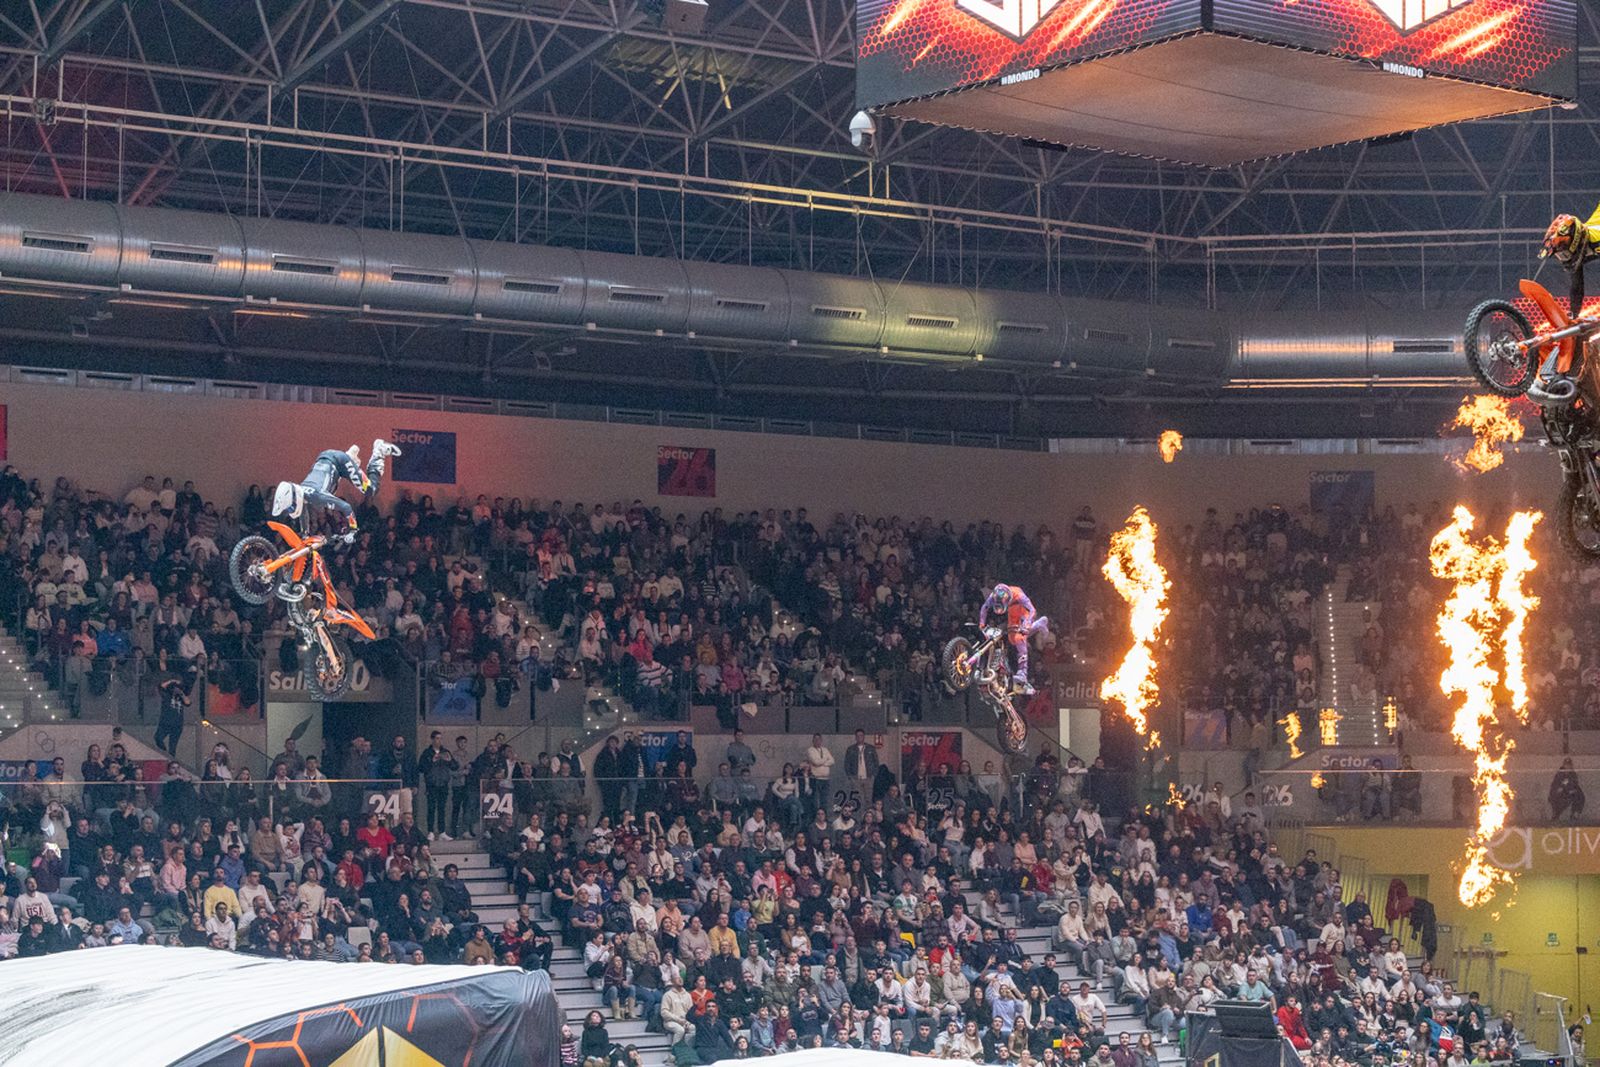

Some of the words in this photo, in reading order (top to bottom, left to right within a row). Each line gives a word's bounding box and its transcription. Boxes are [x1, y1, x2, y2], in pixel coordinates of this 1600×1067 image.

[391, 430, 433, 445] Sector
[656, 447, 694, 461] Sector
[1309, 471, 1350, 483] Sector
[901, 732, 940, 747] Sector
[1321, 754, 1369, 768] Sector
[834, 790, 862, 812] 25
[928, 788, 954, 811] 25
[1182, 783, 1204, 805] 26
[369, 794, 400, 820] 24
[483, 793, 514, 818] 24
